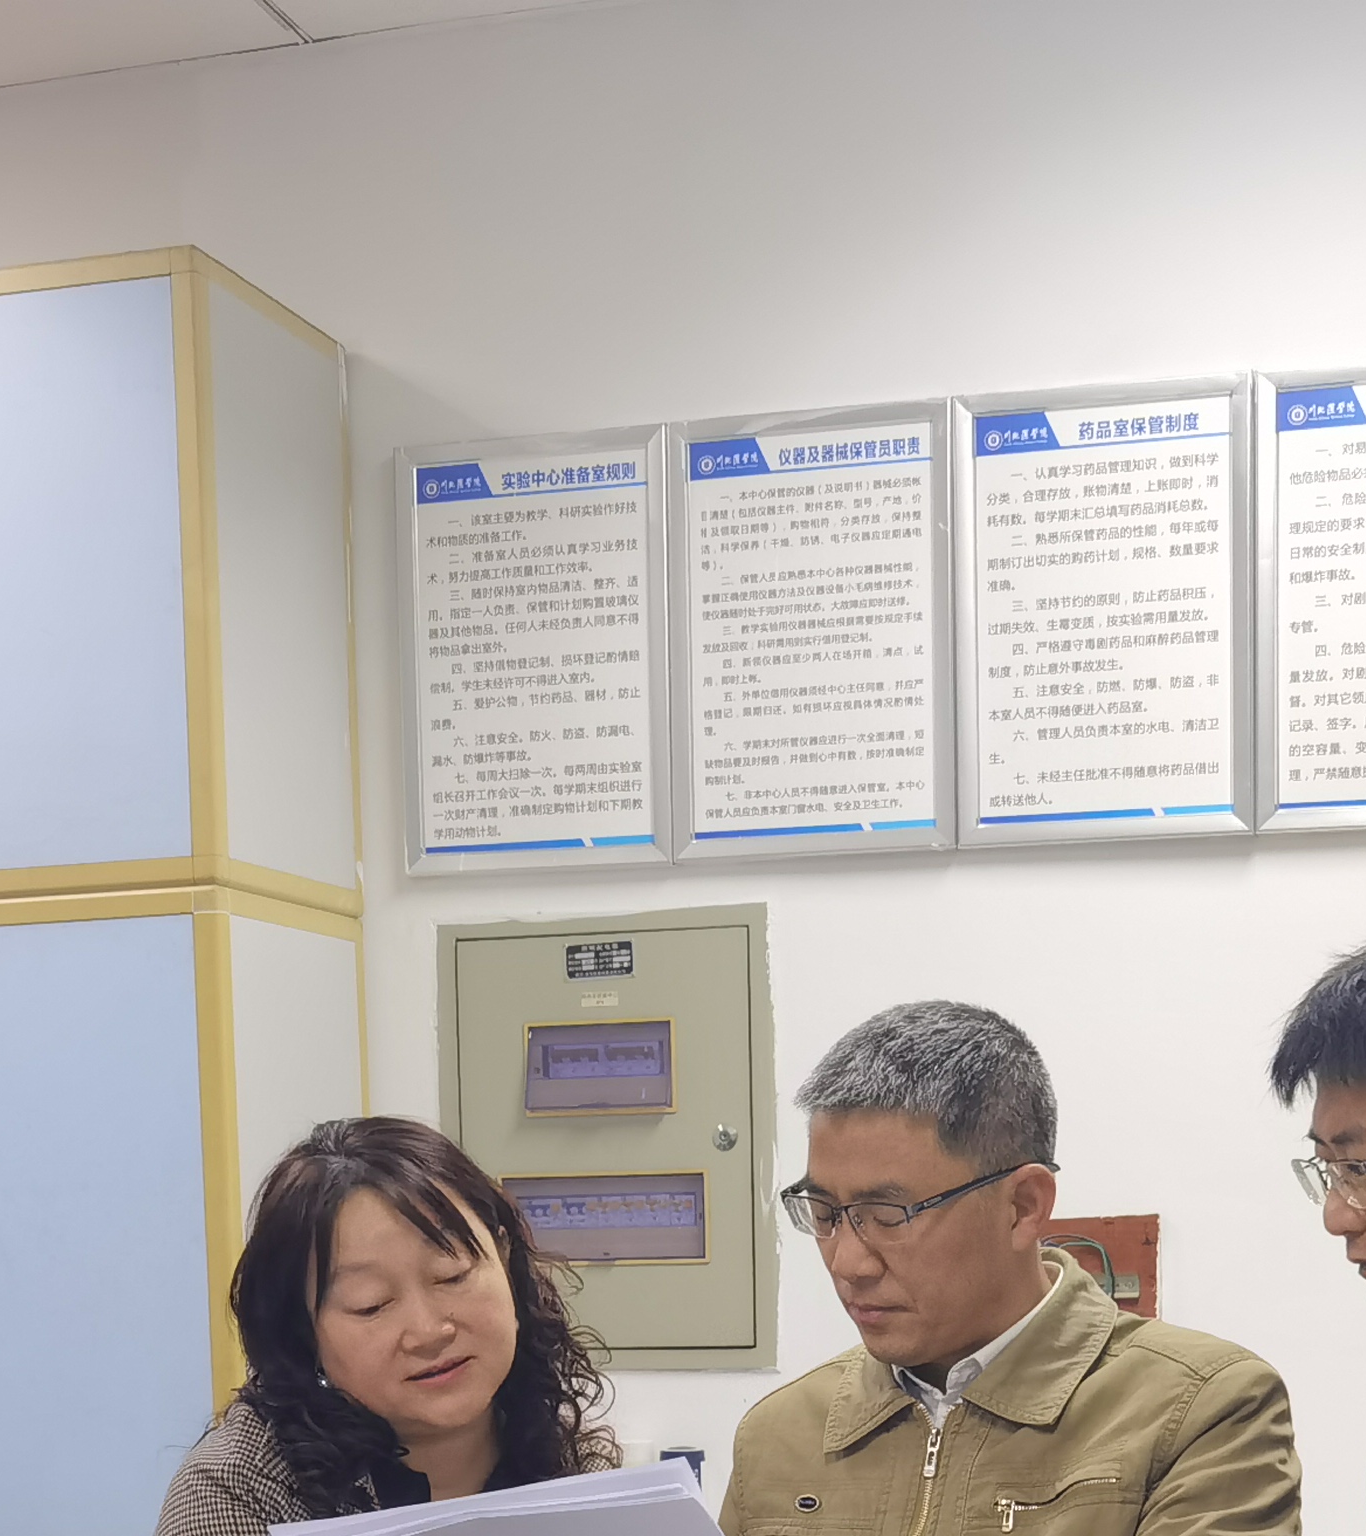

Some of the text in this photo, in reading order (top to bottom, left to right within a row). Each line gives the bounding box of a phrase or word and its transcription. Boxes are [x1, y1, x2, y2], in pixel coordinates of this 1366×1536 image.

[1078, 411, 1200, 441] 药品室保管制度
[778, 436, 921, 467] 仪器及器械保管员职责
[501, 461, 636, 491] 实验中心准备室规则
[1009, 451, 1220, 481] 一、认真学习药品管理知识，做到科学
[984, 474, 1220, 506] 分类，合理存放，账物清楚，上账即时，消
[985, 497, 1209, 527] 耗有数。每学期末汇总填写药品消耗总数。
[1009, 518, 1220, 547] 二、熟悉所保管药品的性能，每年或每
[985, 540, 1220, 571] 期制订出切实的购药计划，规格、数量要求
[985, 578, 1016, 592] 准确。
[1010, 585, 1215, 612] 三、坚持节约的原则，防止药品积压，
[986, 607, 1209, 636] 过期失效、生霉变质，按实验需用量发放。
[1010, 628, 1220, 656] 四、严格遵守毒剧药品和麻醉药品管理
[986, 657, 1124, 679] 制度，防止意外事故发生。
[1010, 673, 1220, 699] 五、注意安全，防燃、防爆、防盗，非
[986, 699, 1149, 722] 本室人员不得随便进入药品室。
[1011, 716, 1220, 742] 六、管理人员负责本室的水电、清洁卫
[987, 752, 1006, 765] 生。
[1011, 760, 1220, 785] 七、未经主任批准不得随意将药品借出
[987, 792, 1054, 807] 或转送他人。
